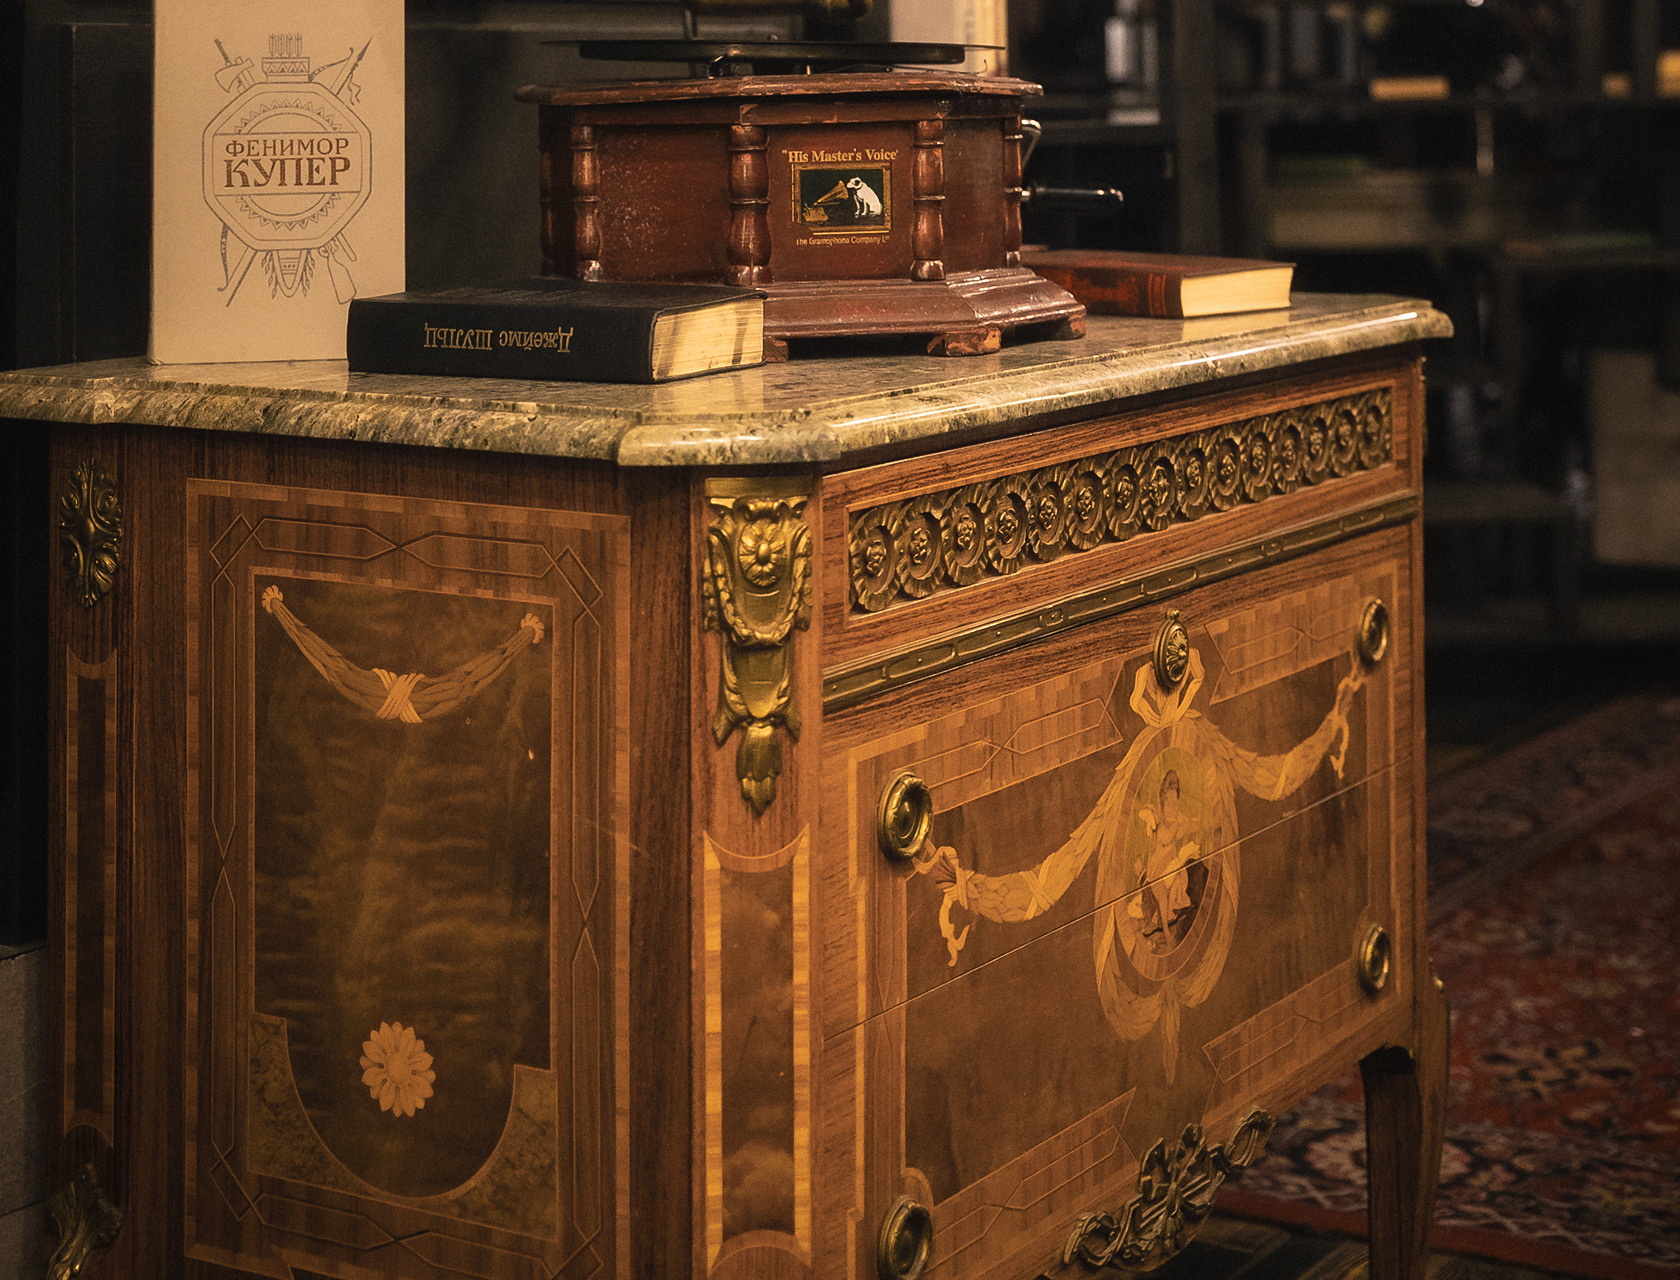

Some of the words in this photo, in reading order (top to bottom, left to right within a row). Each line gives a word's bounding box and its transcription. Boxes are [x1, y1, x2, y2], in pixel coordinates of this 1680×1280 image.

[225, 138, 349, 157] ФЕНИМОР
[811, 148, 862, 162] Master's
[223, 157, 351, 188] КУПЕР
[850, 235, 880, 245] Company
[424, 323, 493, 350] ШУЛЬЦ
[499, 326, 574, 353] Джеймс
